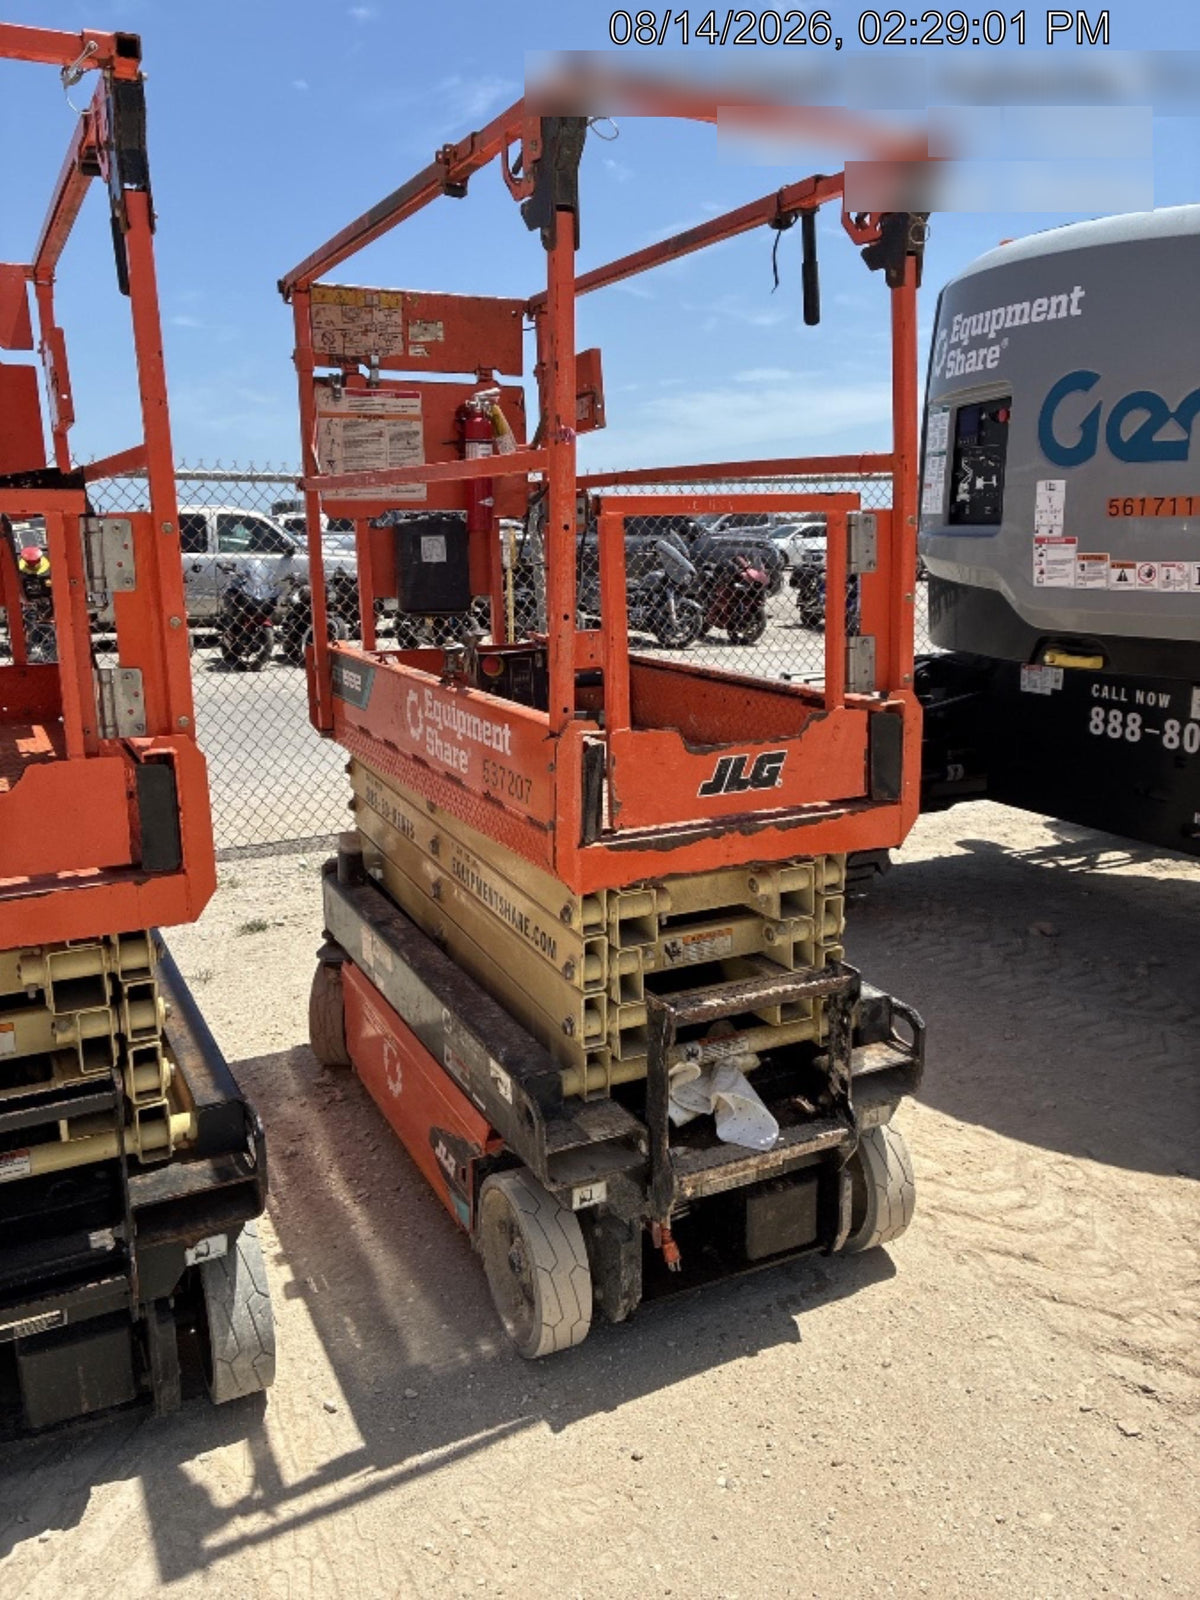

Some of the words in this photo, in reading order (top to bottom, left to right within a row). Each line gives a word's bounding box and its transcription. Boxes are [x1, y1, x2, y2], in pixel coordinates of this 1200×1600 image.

[950, 285, 1086, 346] Equipment
[1108, 496, 1194, 517] 561711
[1091, 683, 1129, 702] CALL
[1135, 689, 1171, 709] NOW
[424, 687, 512, 757] Equipment
[1089, 706, 1200, 754] 888-80
[425, 724, 470, 776] Share
[697, 749, 788, 798] JLG
[451, 855, 558, 960] EQUIPMENTSHARE.COM
